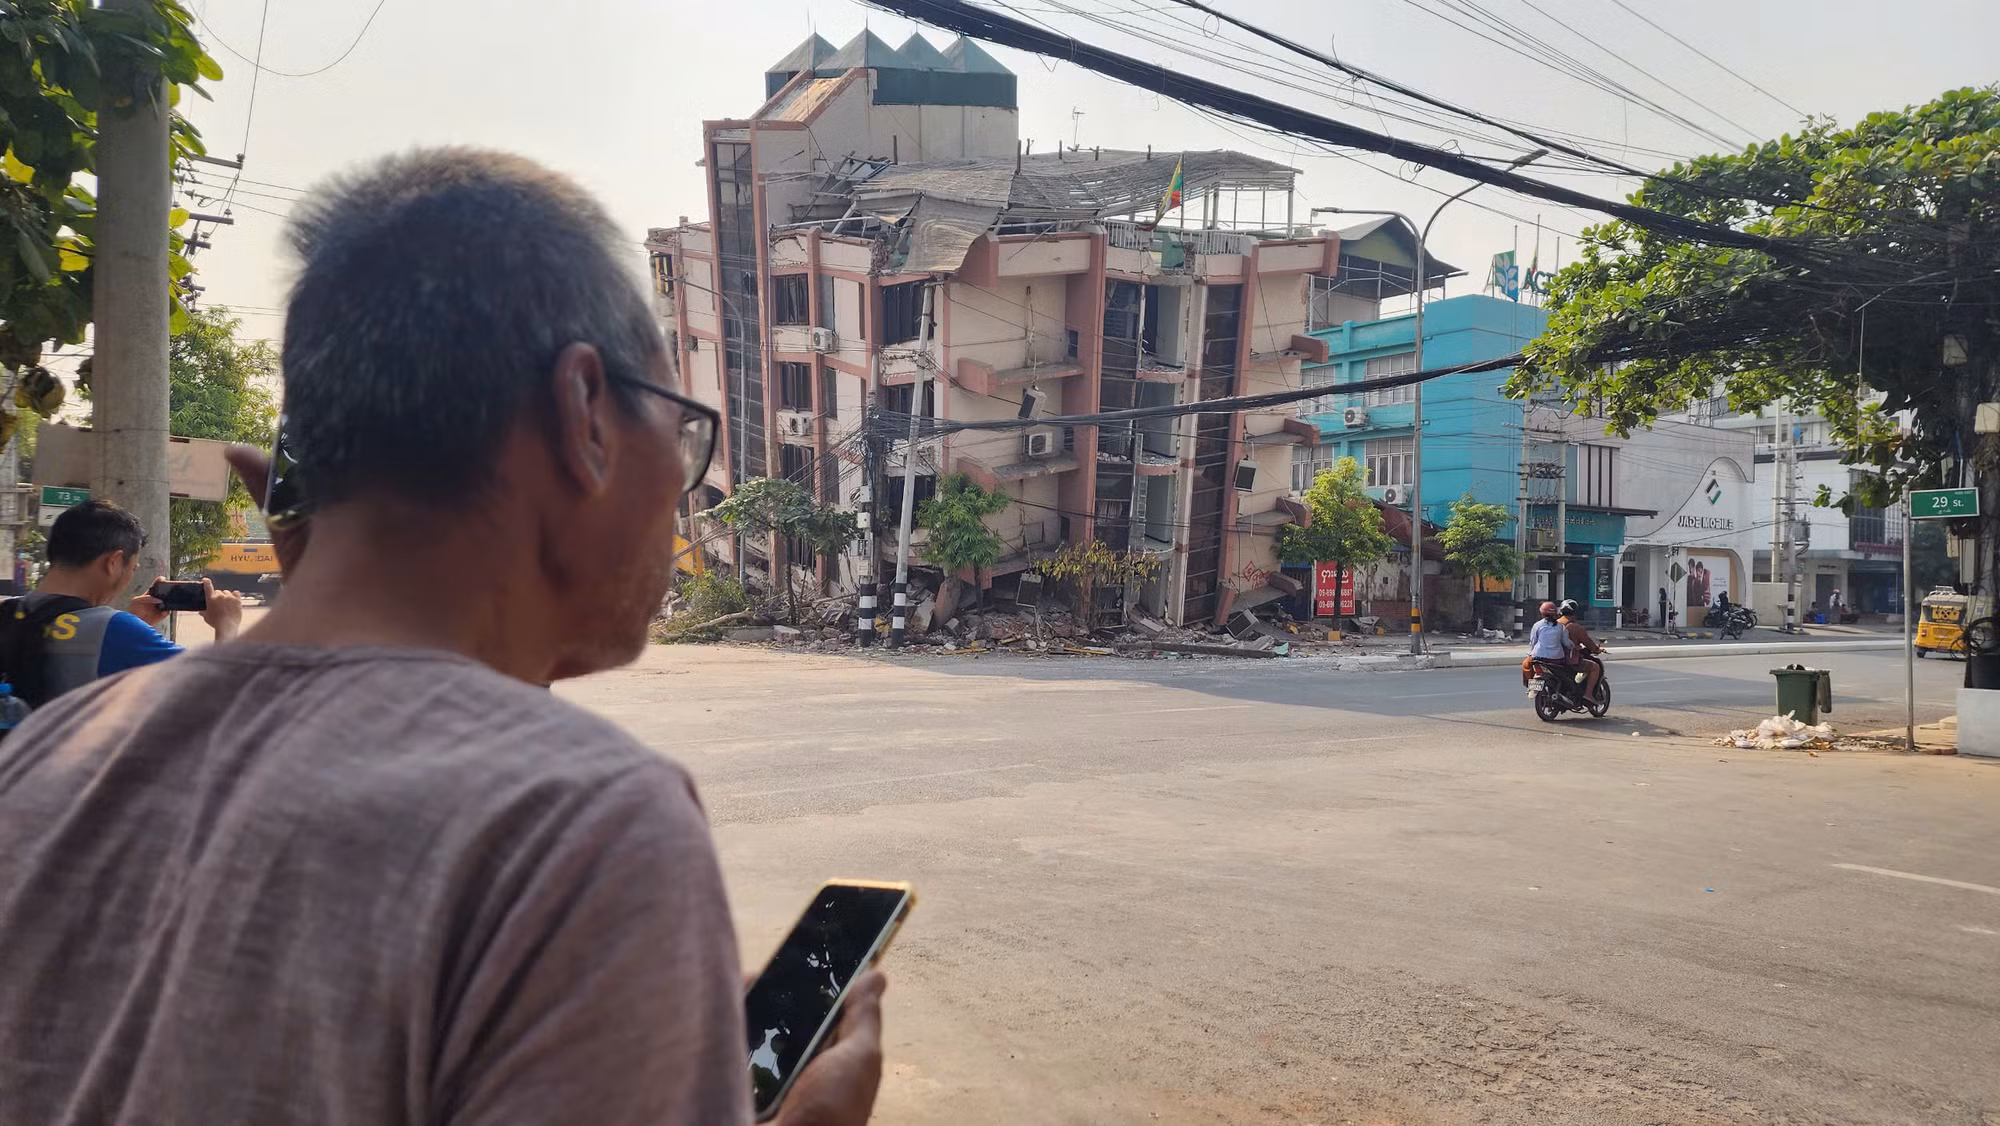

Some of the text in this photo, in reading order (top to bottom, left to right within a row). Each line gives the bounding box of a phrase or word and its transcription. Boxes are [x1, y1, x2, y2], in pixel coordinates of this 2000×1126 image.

[57, 491, 71, 500] 73
[1932, 496, 1965, 508] 29 St.
[1678, 515, 1734, 530] JADE MOBILE
